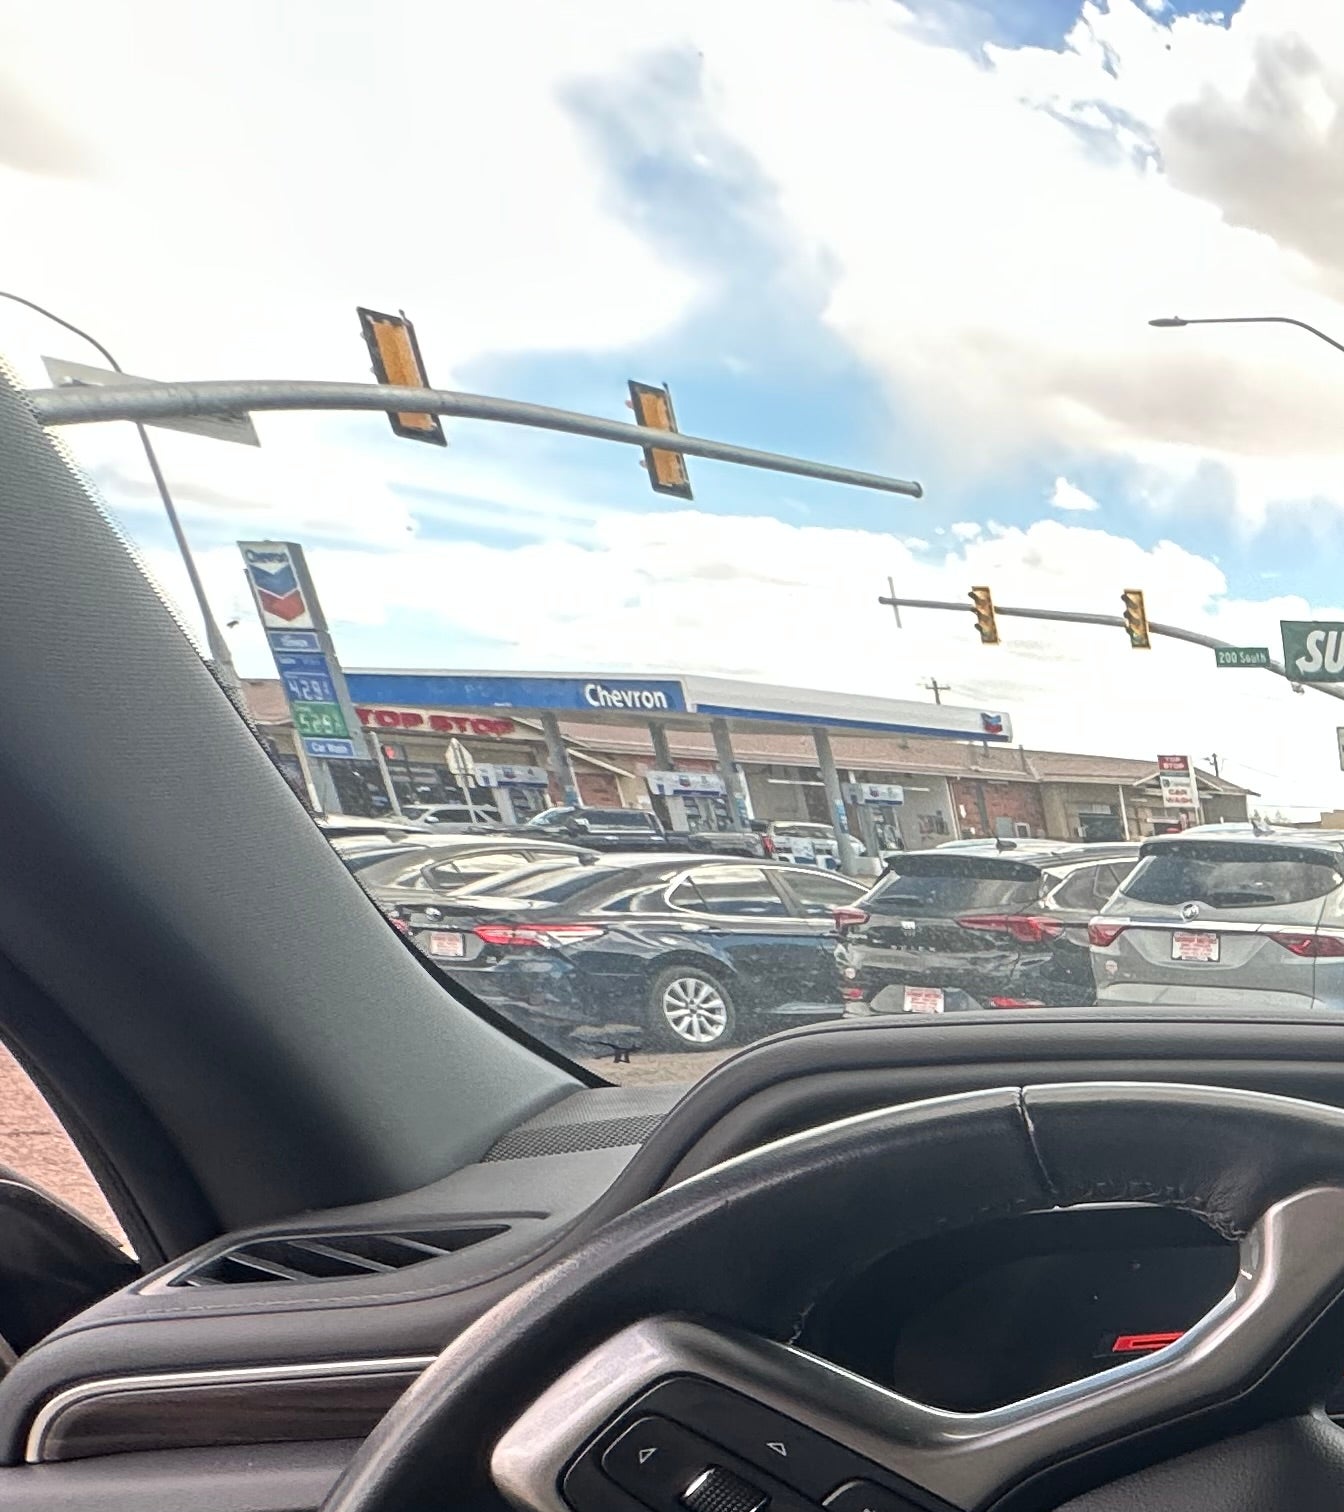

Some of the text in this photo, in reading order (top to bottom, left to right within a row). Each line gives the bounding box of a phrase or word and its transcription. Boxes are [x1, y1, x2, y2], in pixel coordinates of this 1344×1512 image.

[1218, 651, 1267, 664] 200 South
[585, 683, 668, 709] Chevron
[429, 714, 516, 736] STOP
